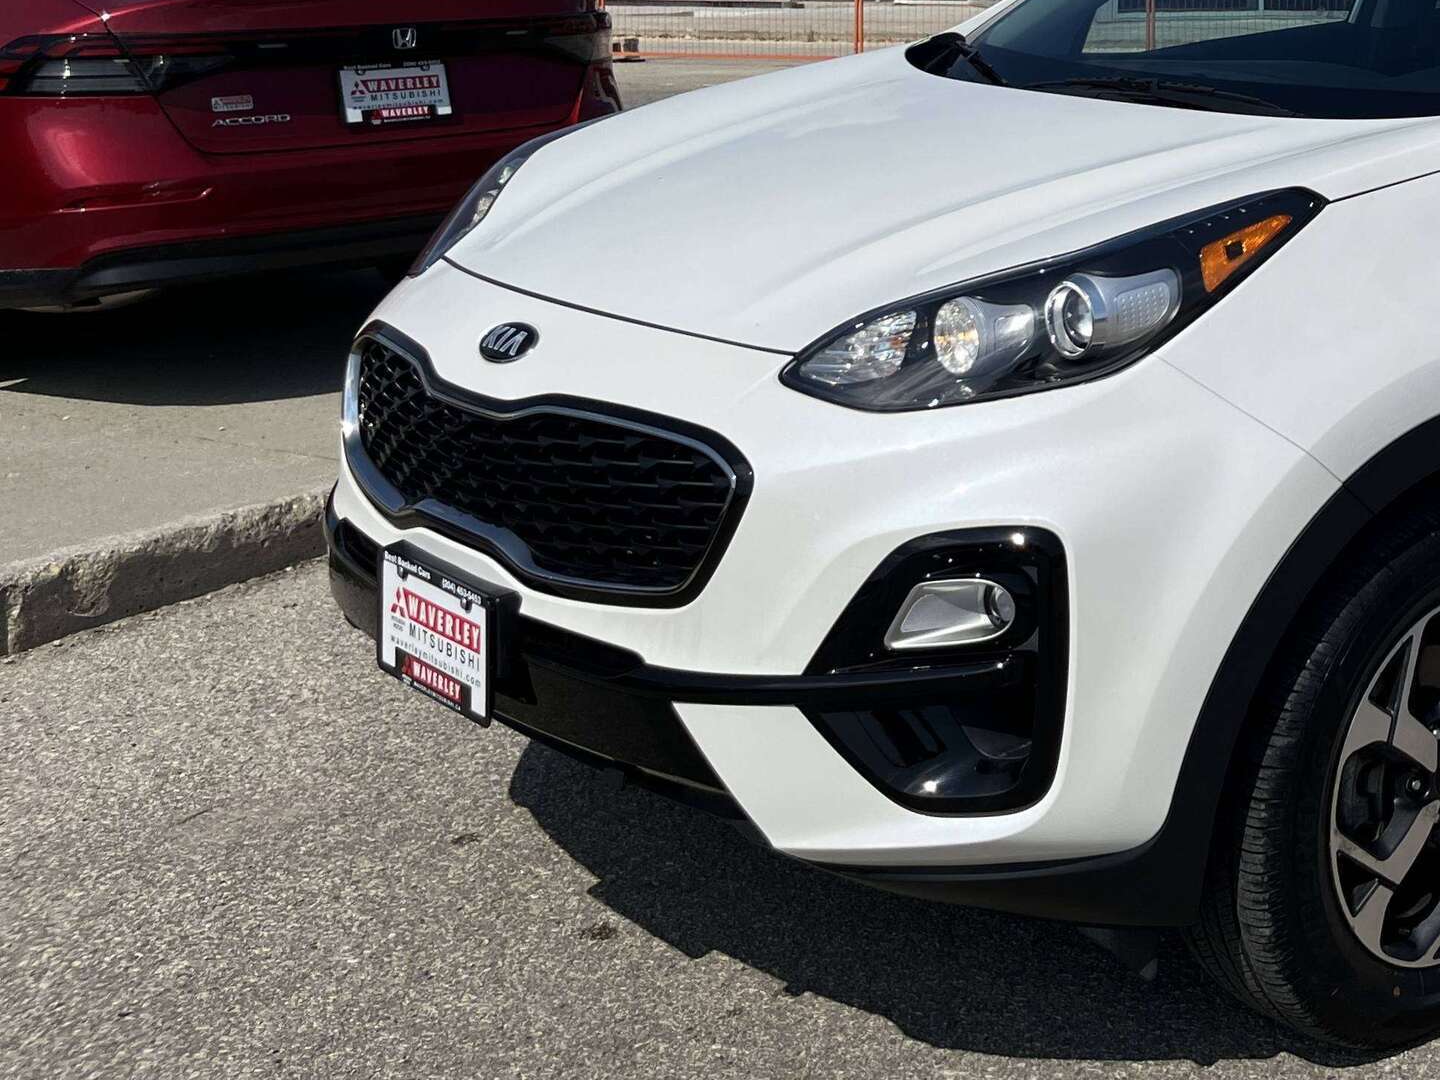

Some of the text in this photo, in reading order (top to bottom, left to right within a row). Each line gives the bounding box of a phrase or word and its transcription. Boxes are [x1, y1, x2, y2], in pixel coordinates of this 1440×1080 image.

[367, 76, 439, 92] WAVERLEY
[370, 89, 441, 101] MITSUBISHI
[212, 114, 290, 127] ACCORD
[381, 106, 429, 118] WAVERLEY
[482, 325, 528, 356] KIA
[408, 593, 481, 651] WAVERLEY
[409, 622, 481, 672] MITSUBISHI
[413, 661, 461, 700] WAVERLEY
